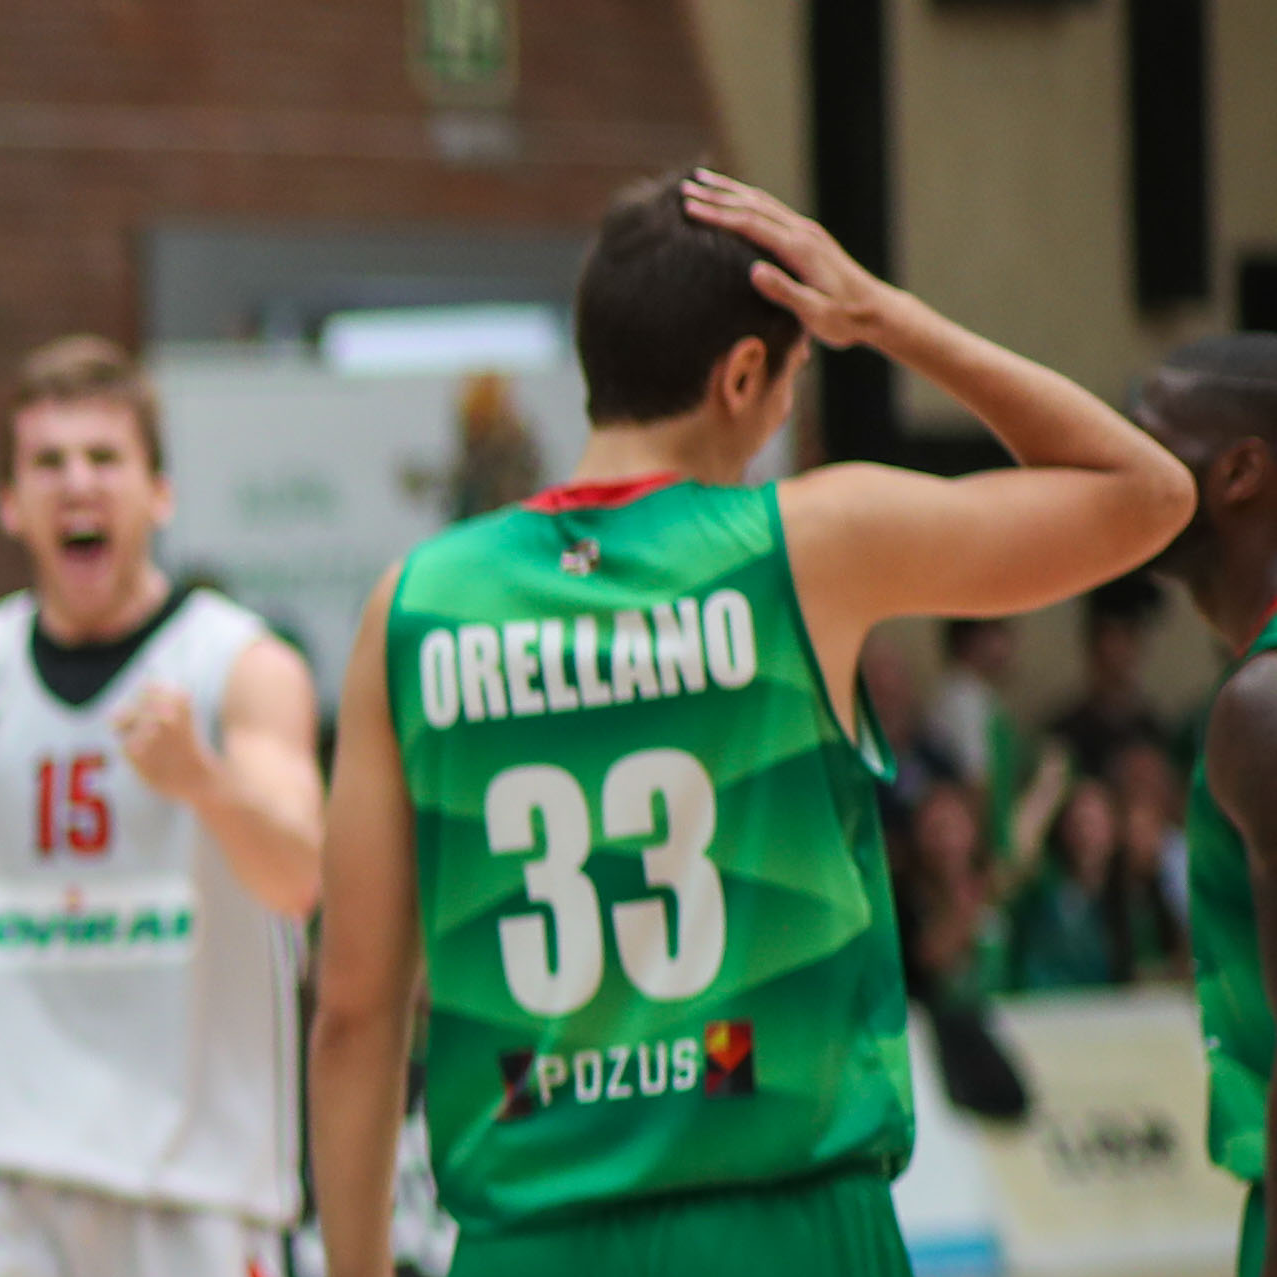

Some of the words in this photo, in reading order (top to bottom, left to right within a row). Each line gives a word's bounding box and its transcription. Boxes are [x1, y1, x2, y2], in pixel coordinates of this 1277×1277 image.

[419, 588, 757, 731] ORELLANO
[35, 753, 113, 858] 15
[484, 747, 727, 1018] 33
[537, 1037, 700, 1108] POZUS
